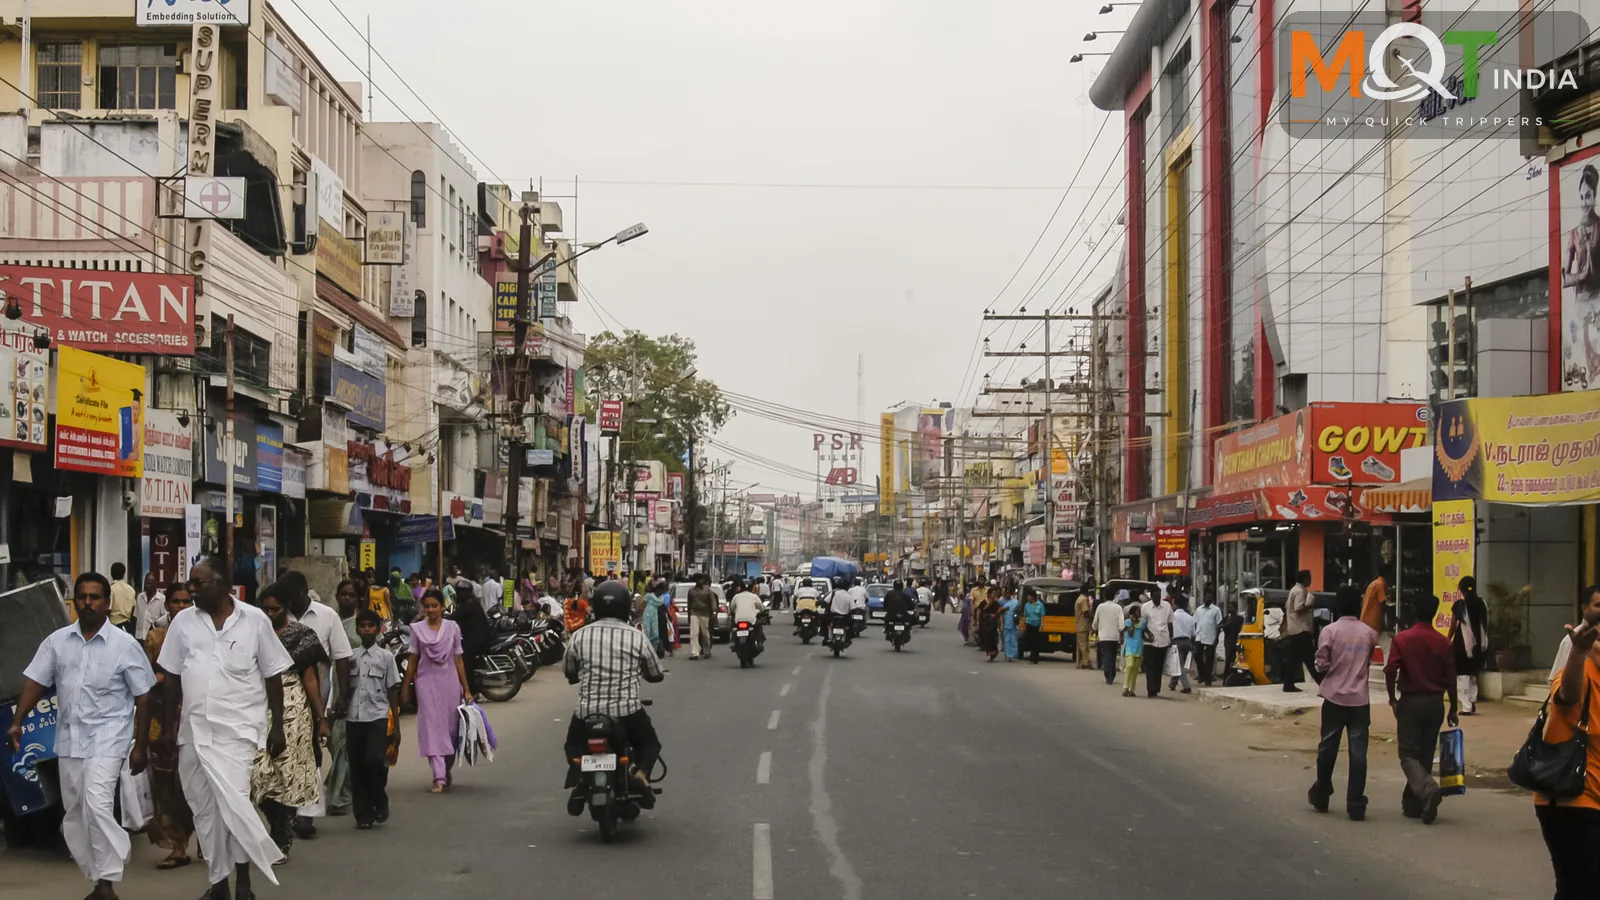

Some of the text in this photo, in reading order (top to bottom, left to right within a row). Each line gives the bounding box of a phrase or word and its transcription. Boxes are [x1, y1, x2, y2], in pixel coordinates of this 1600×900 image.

[146, 12, 237, 22] Embedding Solutions
[20, 276, 189, 325] TITAN
[57, 329, 66, 341] &
[68, 329, 108, 343] WATCH
[114, 332, 189, 347] ACCESSORIES
[216, 422, 248, 469] Suer
[813, 433, 864, 451] PSR
[1318, 425, 1427, 454] GOWT
[1223, 446, 1256, 477] GOWTHAM
[1256, 435, 1293, 468] CHAPPALS
[155, 479, 190, 504] TITAN
[592, 548, 619, 556] BUY 2
[1165, 551, 1179, 559] CAR
[1158, 559, 1187, 567] PARKING
